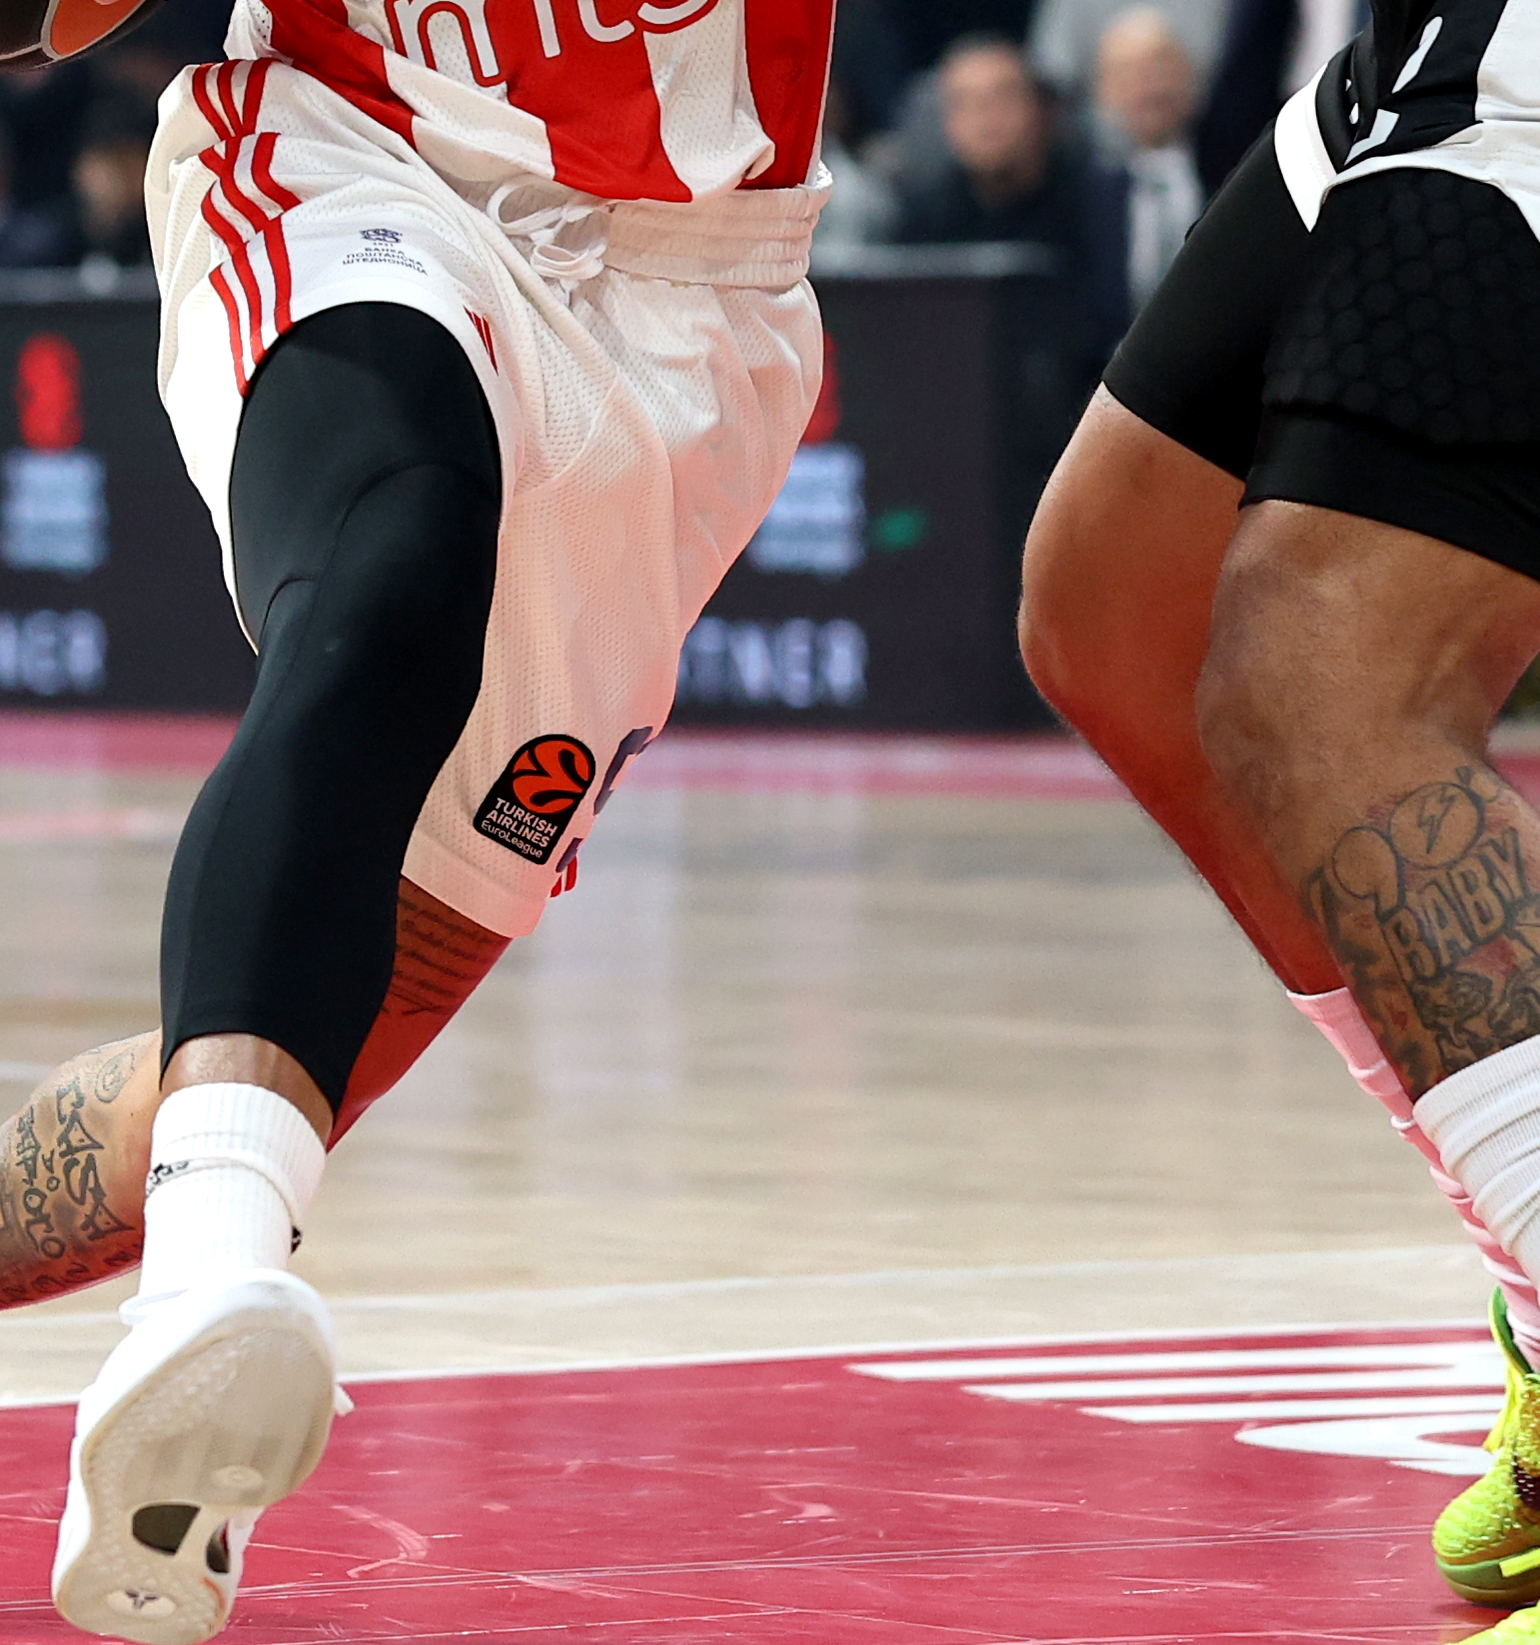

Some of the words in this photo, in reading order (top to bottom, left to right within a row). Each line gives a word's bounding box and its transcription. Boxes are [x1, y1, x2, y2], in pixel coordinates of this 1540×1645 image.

[484, 809, 551, 848] AIRLINES
[495, 796, 559, 837] TURKISH
[480, 819, 544, 858] EuroLeague
[1379, 826, 1527, 984] BABY
